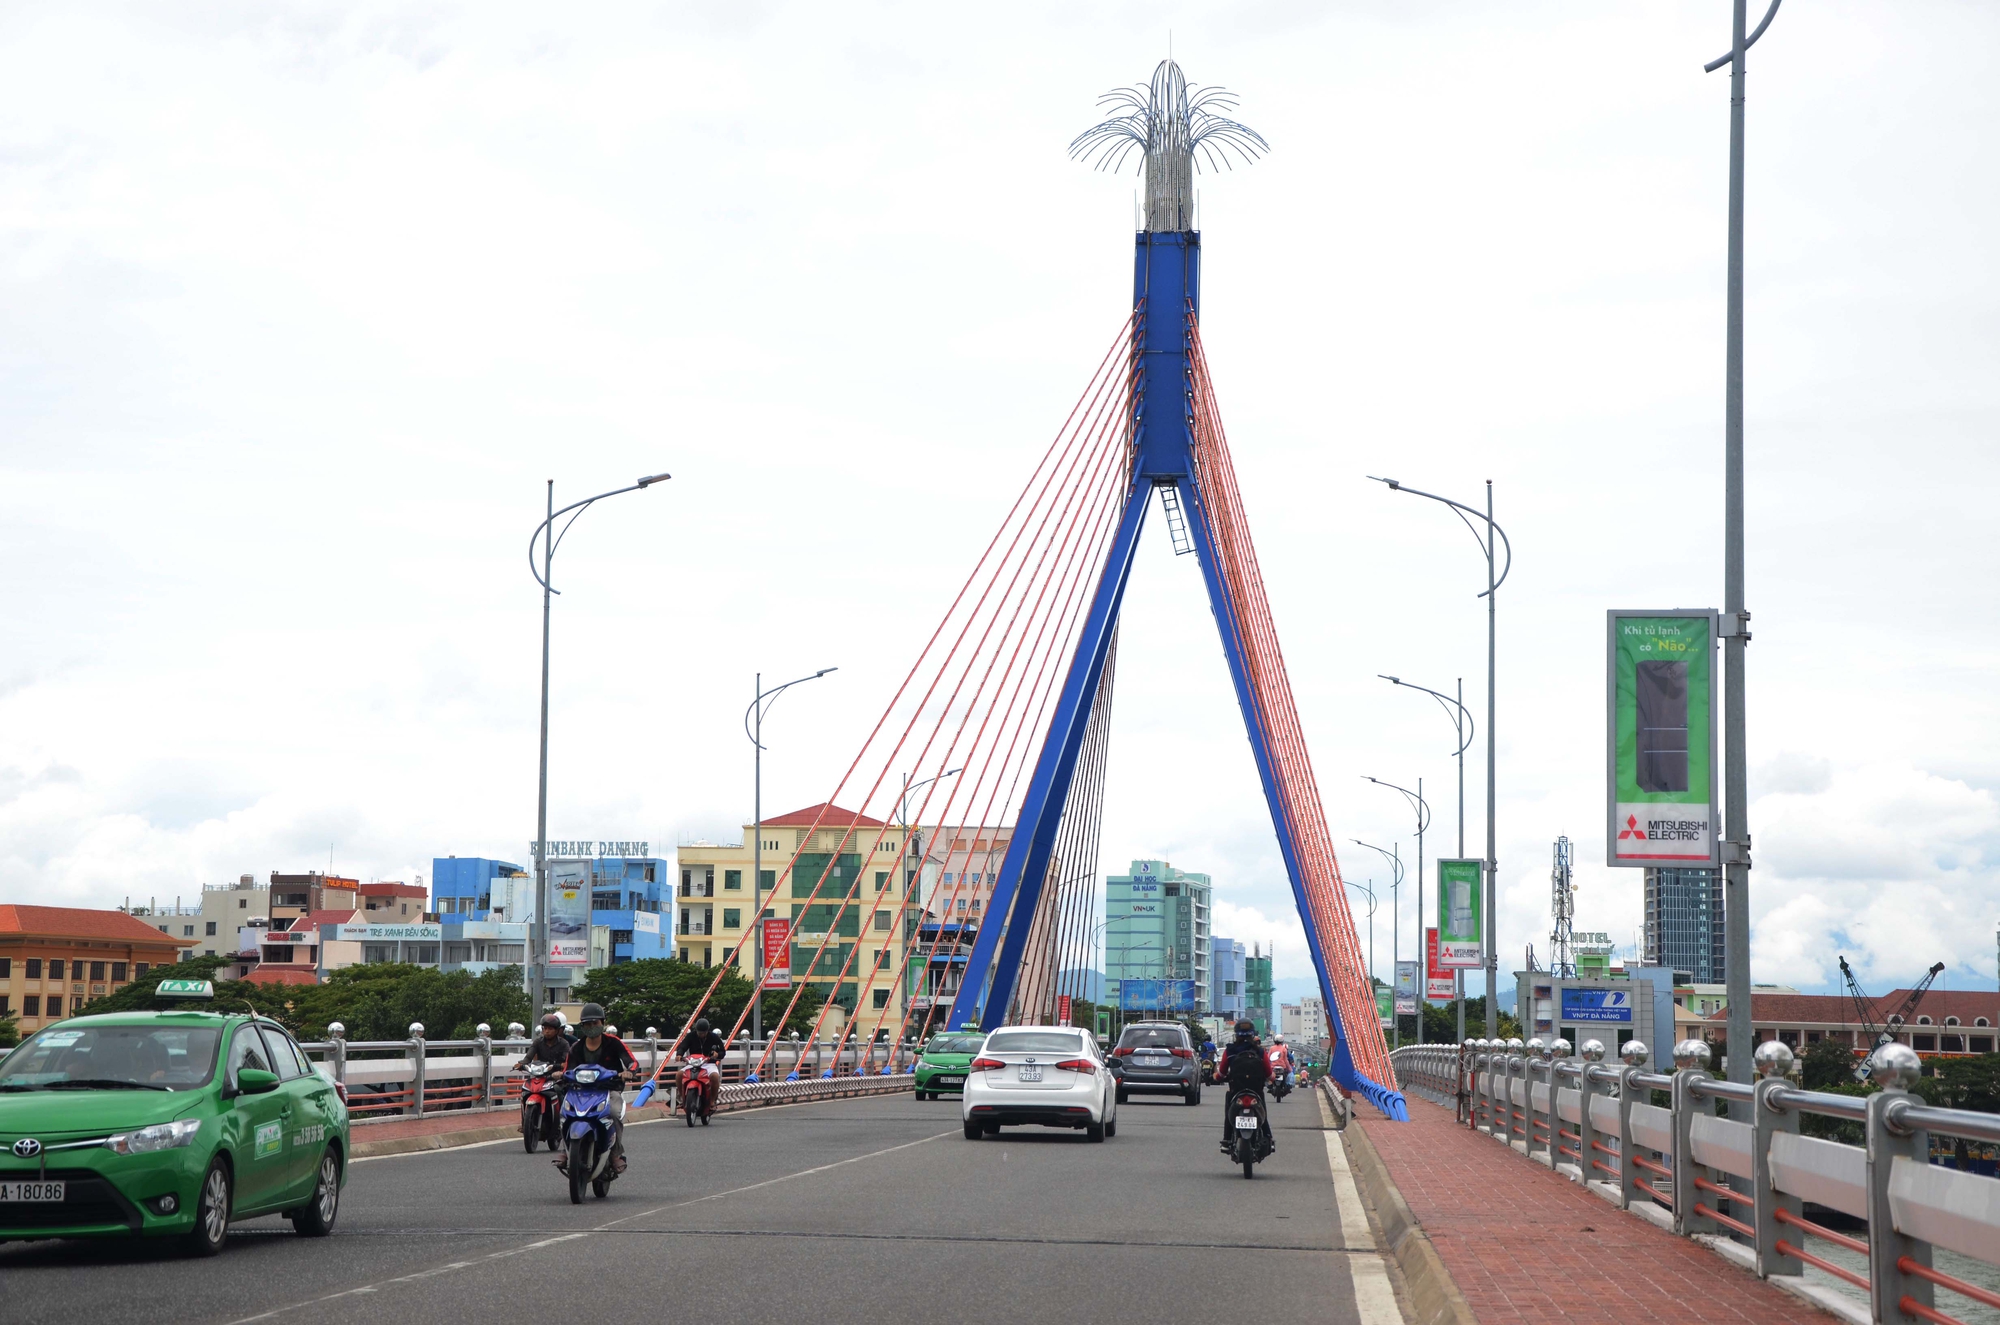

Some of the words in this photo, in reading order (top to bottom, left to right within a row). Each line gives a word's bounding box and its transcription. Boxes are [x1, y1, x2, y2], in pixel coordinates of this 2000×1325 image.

[1624, 625, 1642, 635] Khi
[1658, 625, 1681, 638] lạnh
[1639, 643, 1652, 651] có
[1648, 820, 1708, 831] MITSUBISHI
[1648, 830, 1699, 841] ELECTRIC
[530, 841, 593, 856] EIMBANK
[598, 841, 649, 857] DANANG
[342, 880, 359, 889] HOTEL
[370, 928, 383, 937] TRE
[384, 928, 404, 937] XANH
[419, 926, 439, 938] SÔNG
